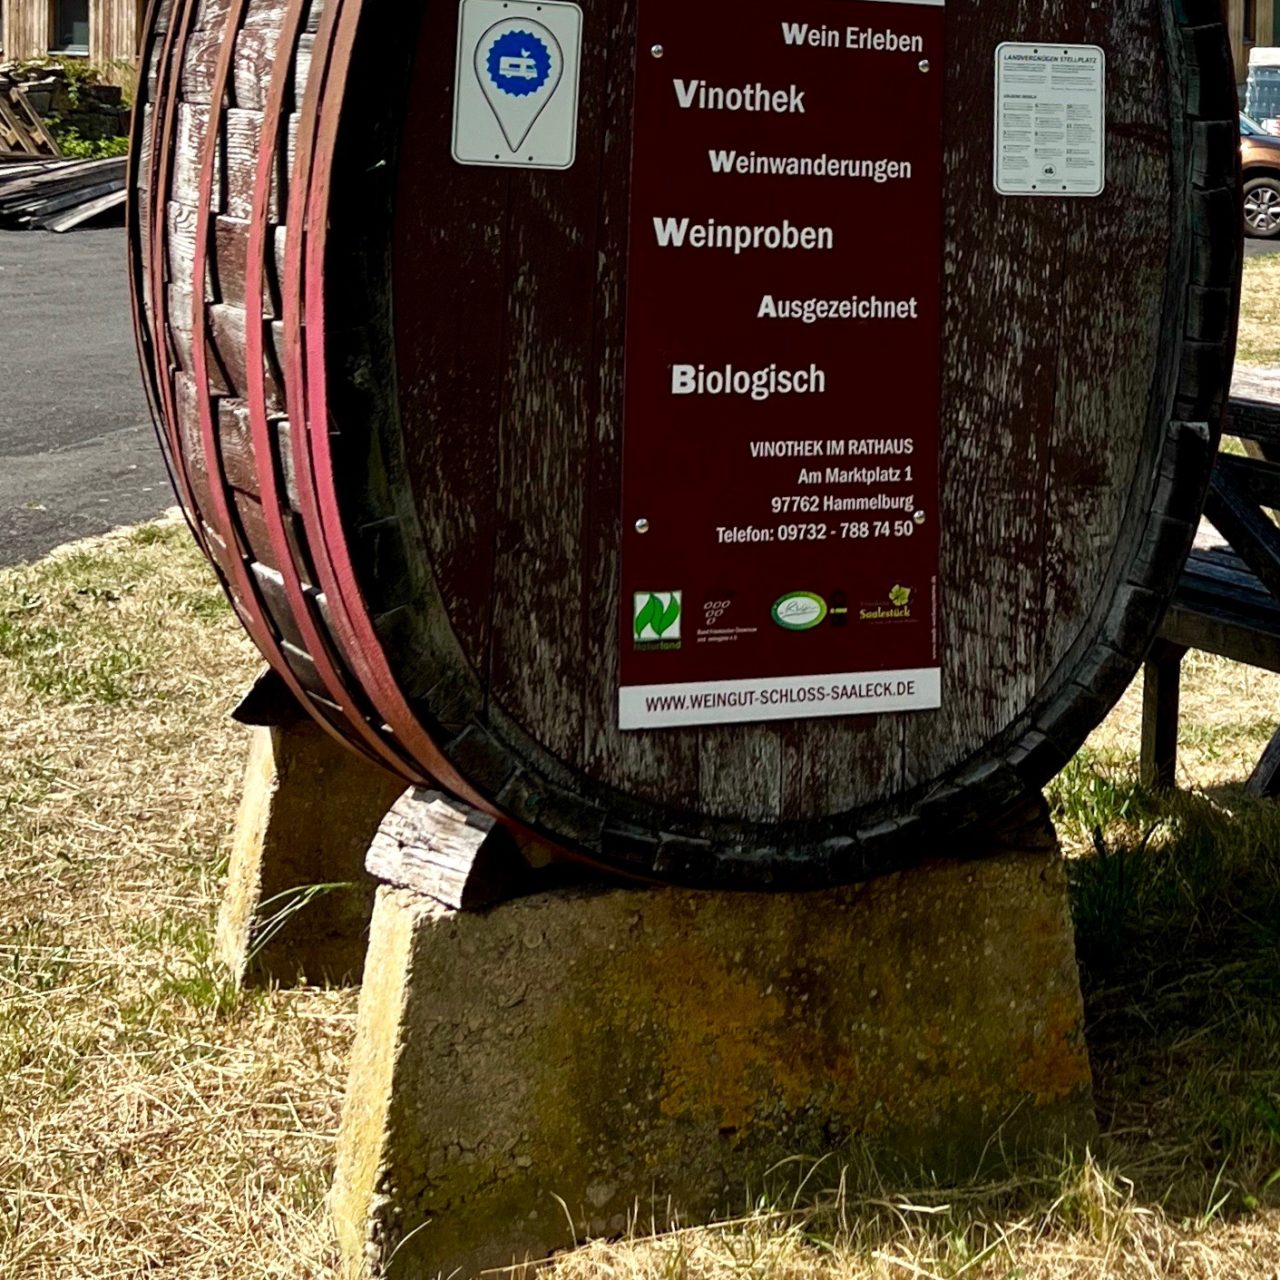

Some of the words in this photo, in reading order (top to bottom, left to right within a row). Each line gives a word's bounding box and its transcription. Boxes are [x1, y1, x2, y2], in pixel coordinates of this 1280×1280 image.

[781, 22, 839, 48] Wein
[846, 26, 923, 53] Erleben
[673, 78, 806, 113] Vinothek
[708, 149, 912, 182] Weinwanderungen
[652, 216, 834, 254] Weinproben
[757, 294, 918, 323] Ausgezeichnet
[671, 363, 826, 400] Biologisch
[750, 440, 823, 458] VINOTHEK
[826, 440, 845, 456] IM
[848, 438, 914, 455] RATHAUS
[798, 468, 822, 485] Am
[825, 468, 901, 486] Marktplatz
[904, 466, 913, 482] 1
[771, 495, 820, 513] 97762
[822, 494, 914, 513] Hammelburg
[716, 526, 775, 544] Telefon:
[777, 523, 827, 541] 09732
[840, 522, 870, 539] 788
[873, 522, 891, 538] 74
[894, 520, 914, 537] 50
[645, 680, 916, 713] WWW.WEINGUT-SCHLOSS-SAALECK.DE
